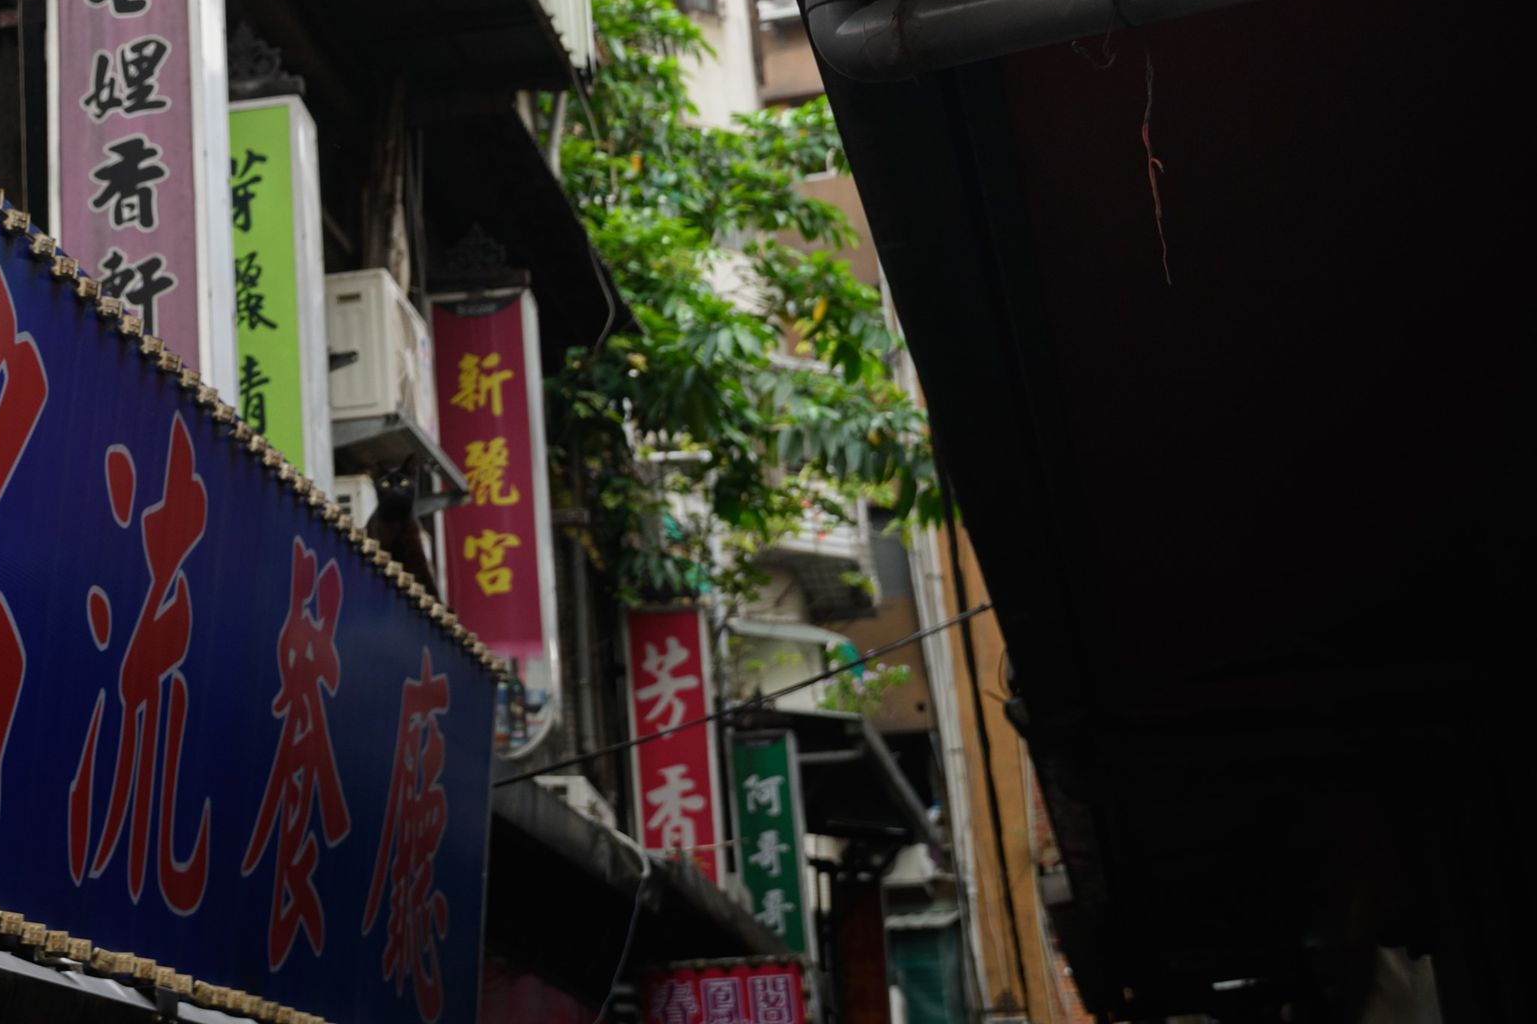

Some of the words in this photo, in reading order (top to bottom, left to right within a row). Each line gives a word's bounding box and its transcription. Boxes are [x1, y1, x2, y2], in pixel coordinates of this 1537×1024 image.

[449, 353, 520, 596] 新麗宮
[743, 773, 796, 936] 阿哥哥
